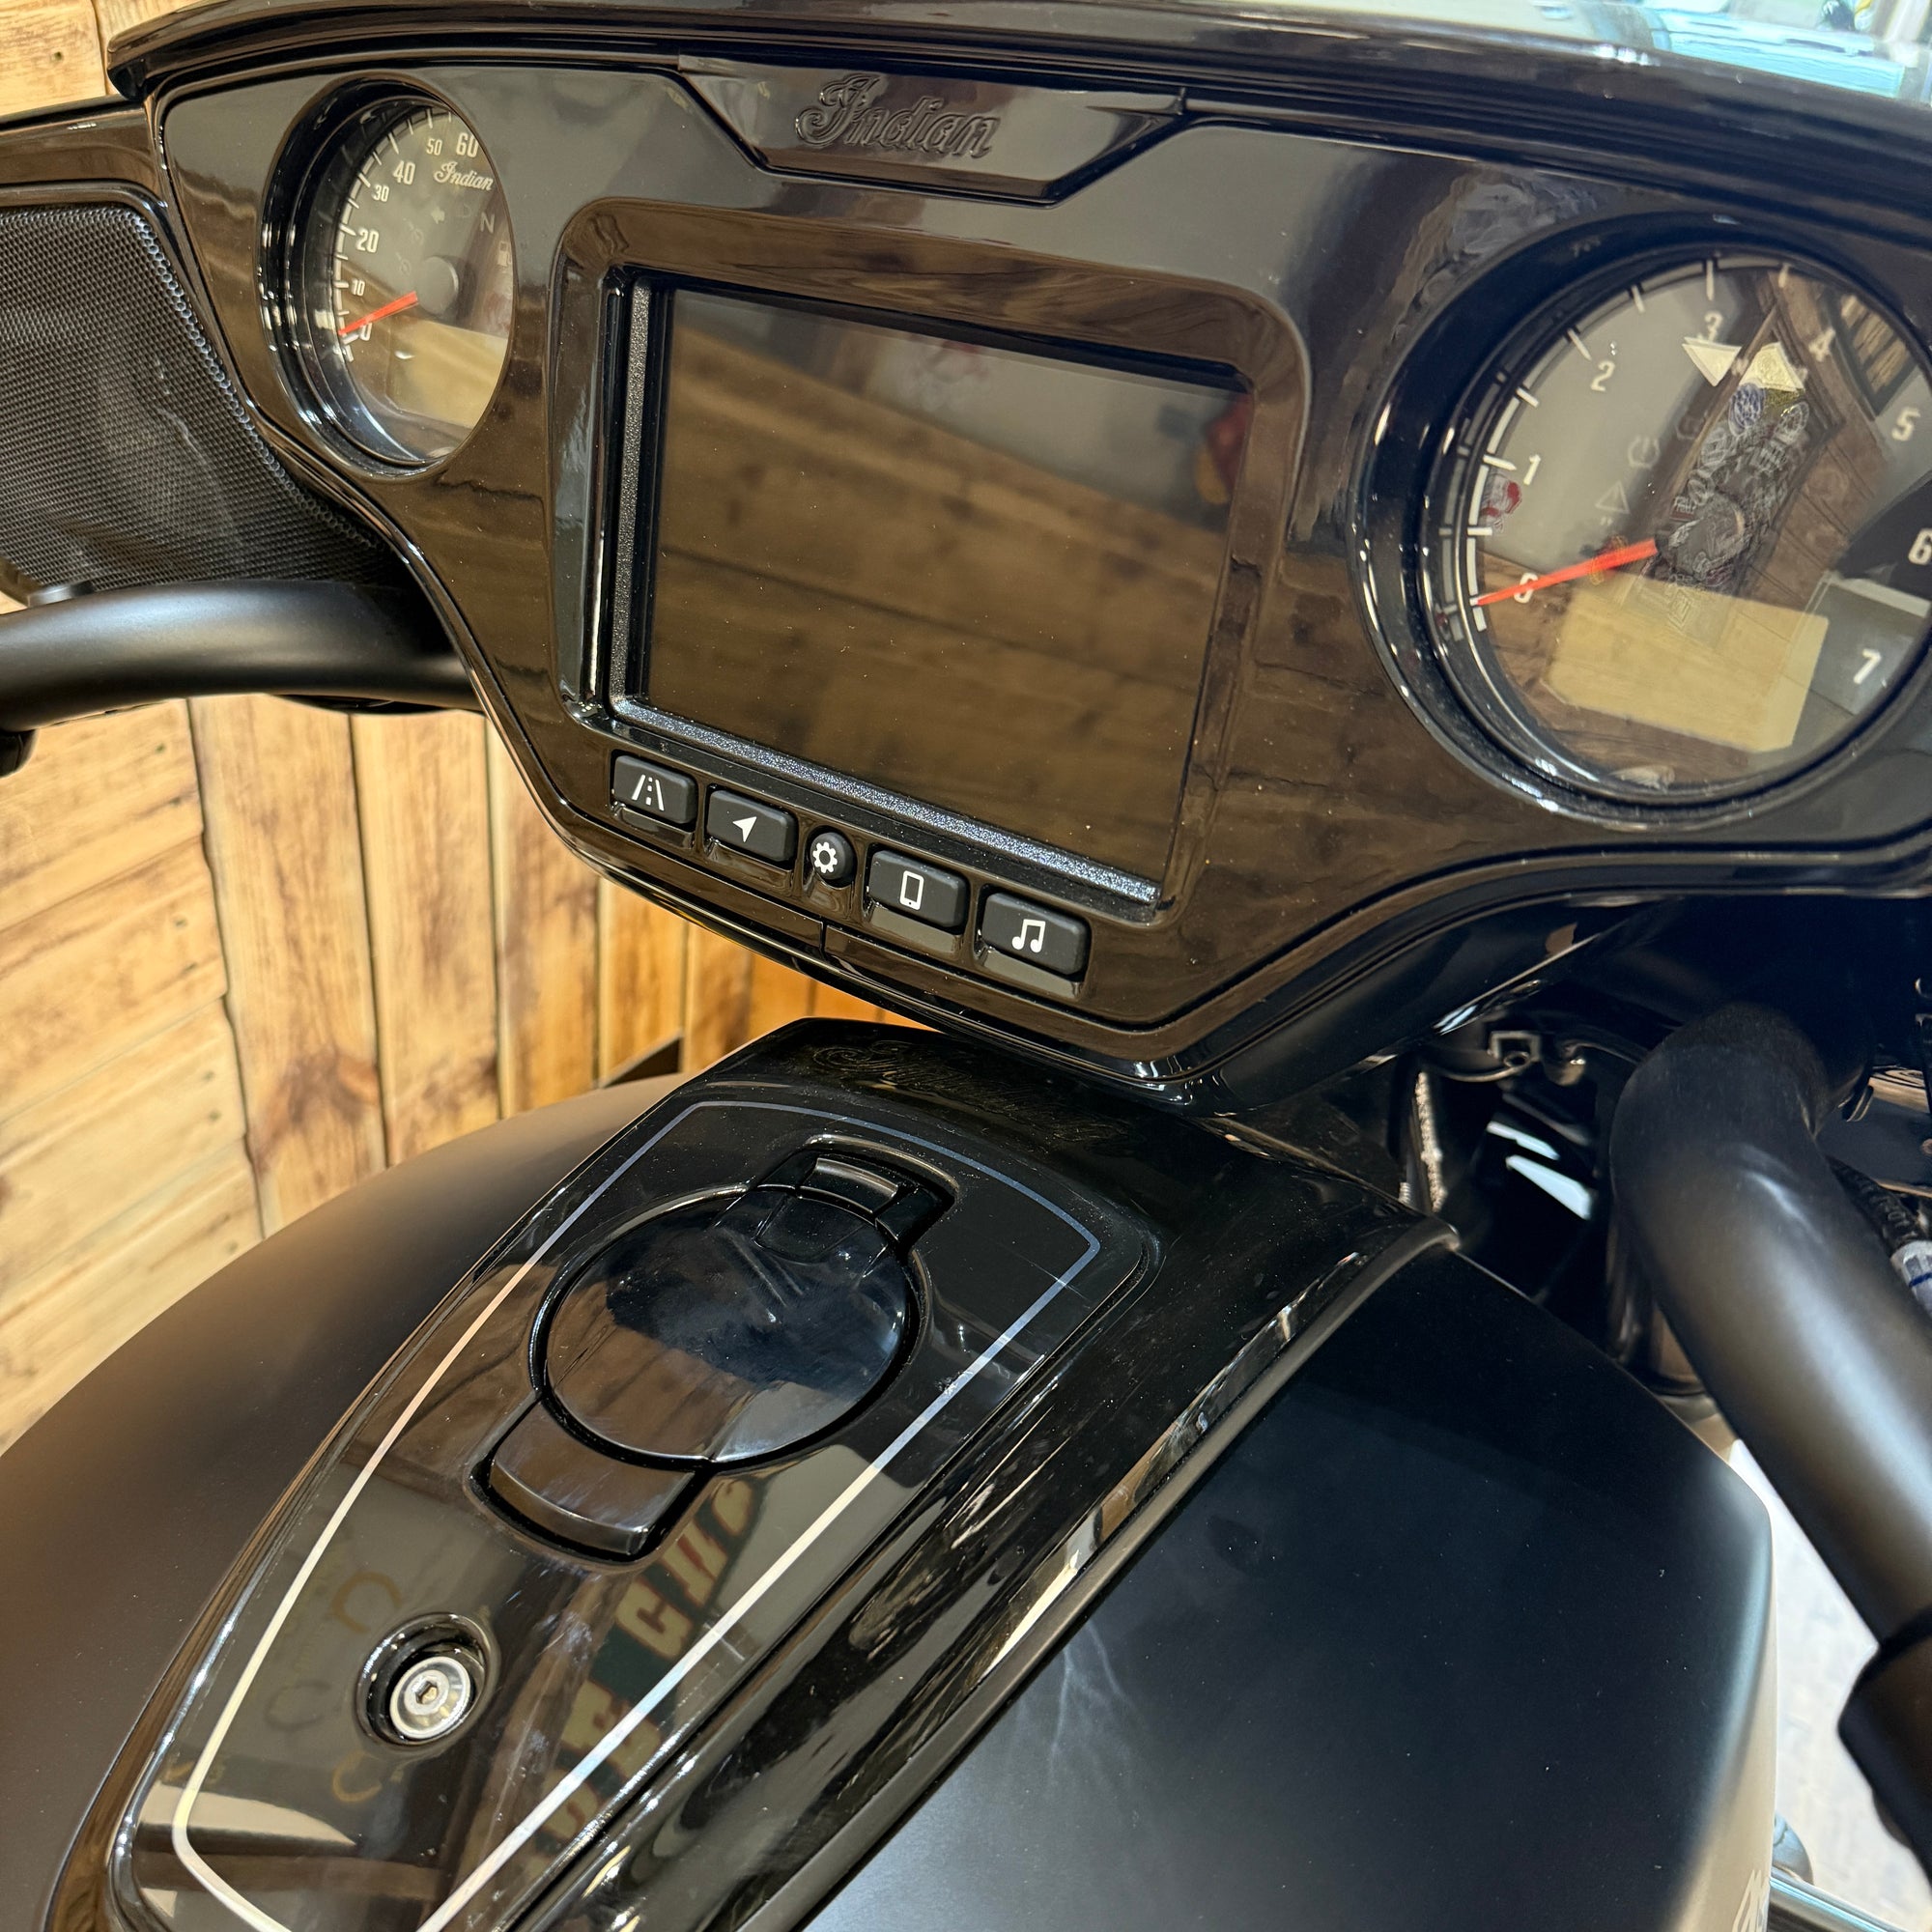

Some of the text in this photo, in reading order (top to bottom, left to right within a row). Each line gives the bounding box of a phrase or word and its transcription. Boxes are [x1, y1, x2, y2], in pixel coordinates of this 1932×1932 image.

[795, 72, 1002, 158] Indian
[426, 138, 443, 156] 50
[456, 132, 479, 158] 60
[393, 160, 416, 185] 40
[433, 160, 494, 191] Indian
[372, 185, 389, 203] 30
[355, 229, 380, 253] 20
[352, 277, 366, 297] 10
[1807, 327, 1835, 362] 4
[1590, 360, 1615, 392] 2
[1890, 406, 1921, 441] 5
[1522, 454, 1542, 485] 1
[1907, 527, 1932, 566] 6
[1853, 648, 1882, 684] 7
